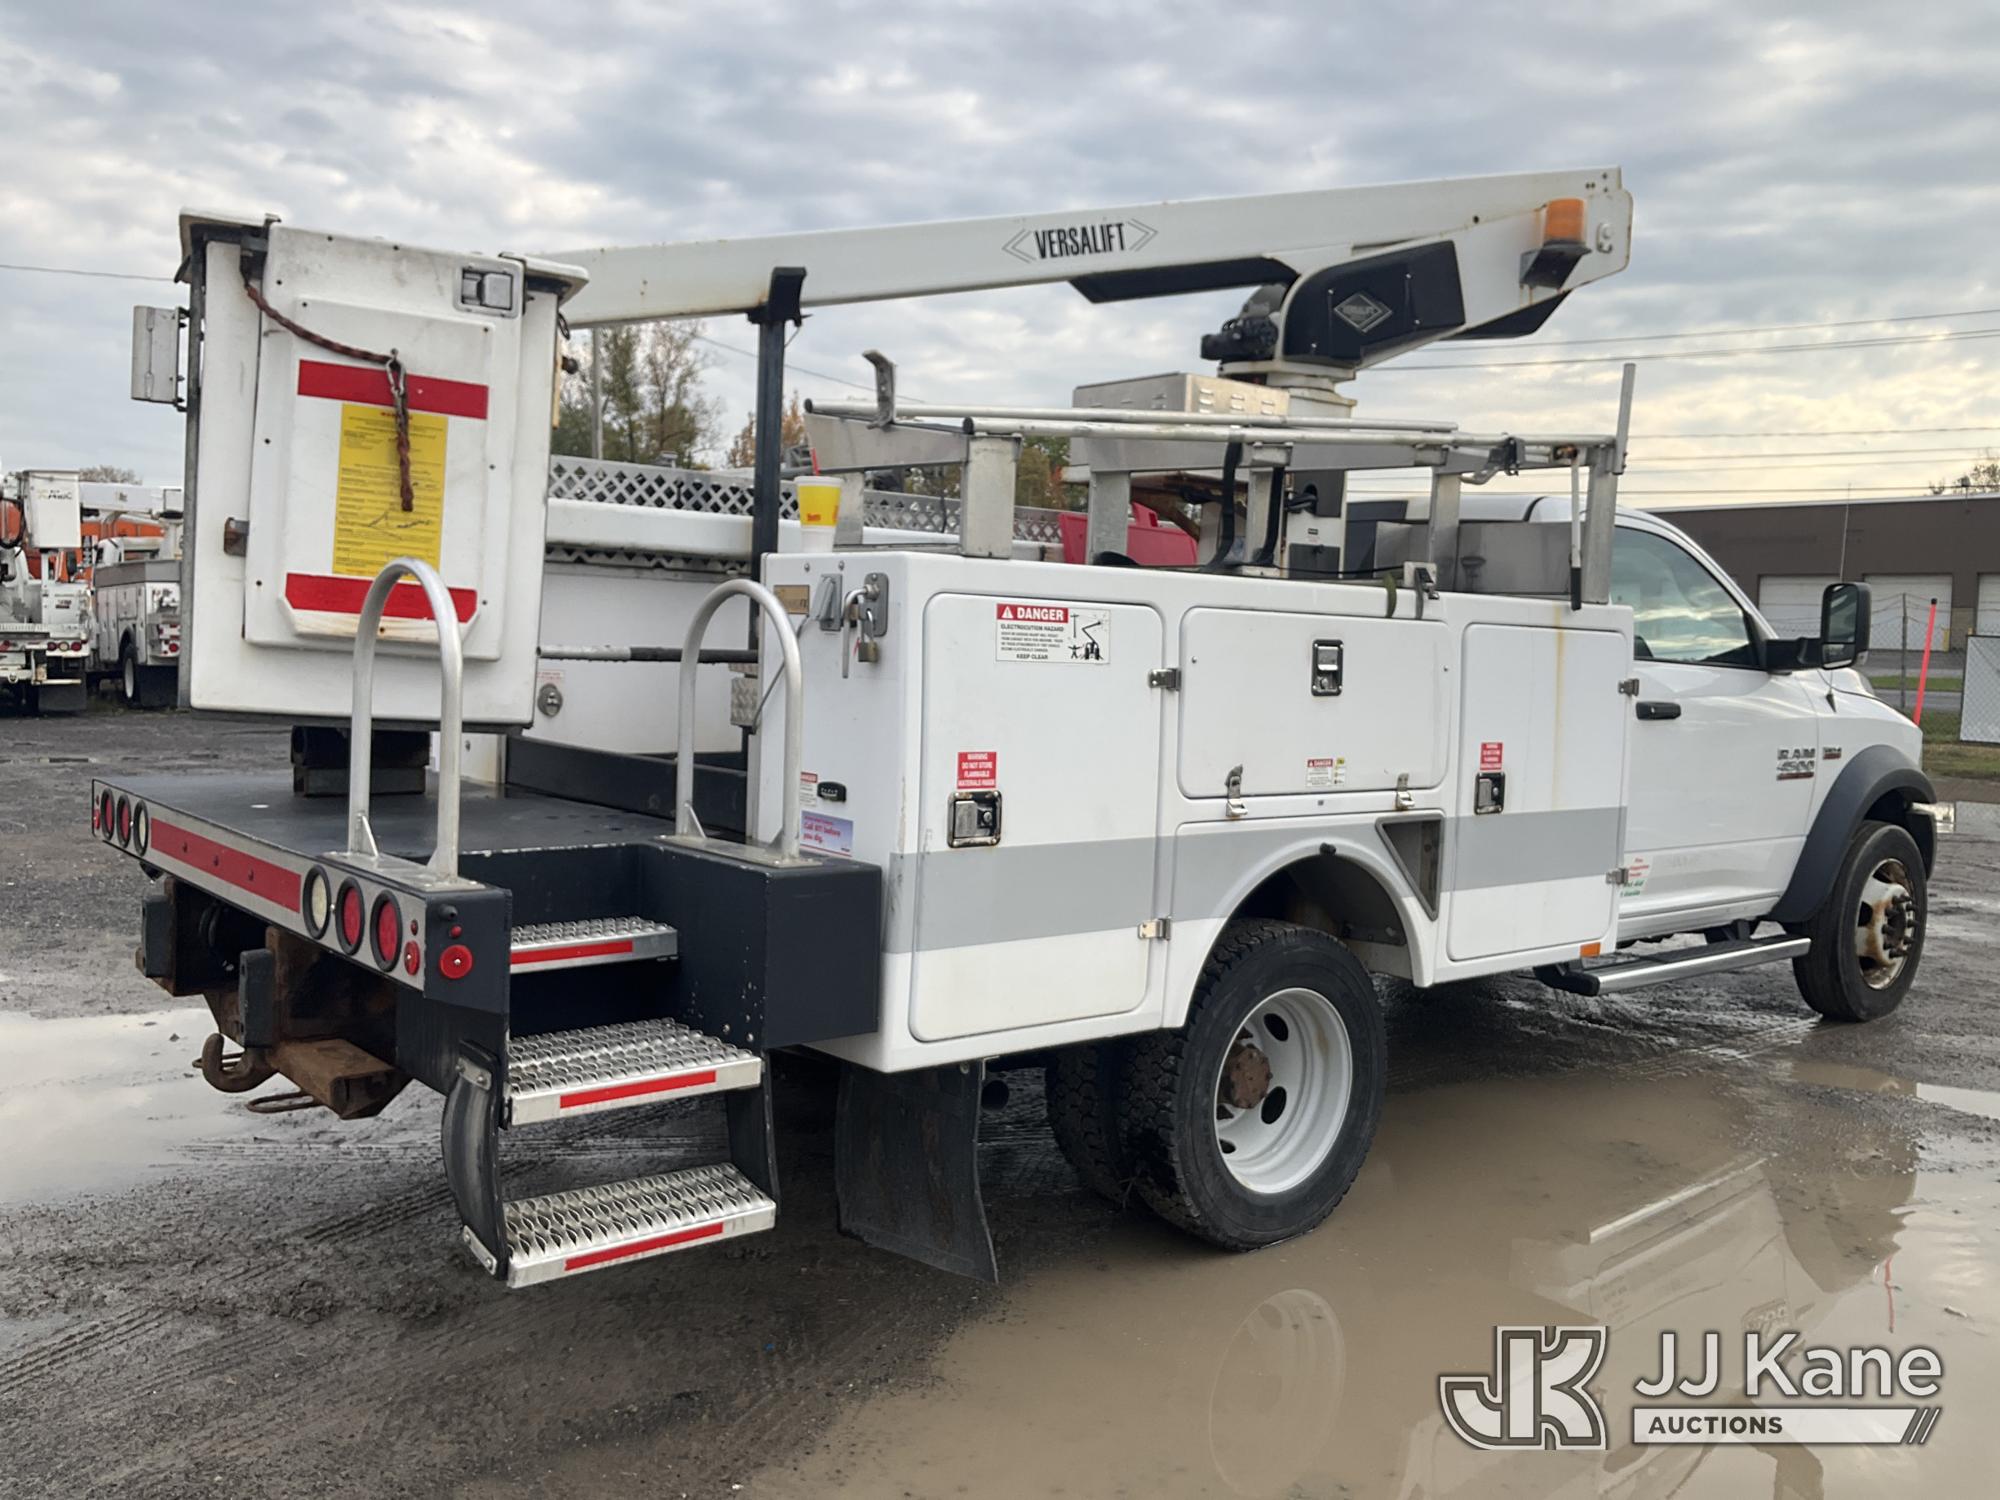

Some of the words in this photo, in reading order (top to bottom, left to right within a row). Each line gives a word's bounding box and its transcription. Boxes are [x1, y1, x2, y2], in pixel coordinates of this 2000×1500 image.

[1034, 222, 1125, 260] VERSALIFT
[1016, 607, 1064, 621] DANGER
[1000, 623, 1043, 631] ELECTROCUTION
[1777, 747, 1816, 760] RAM
